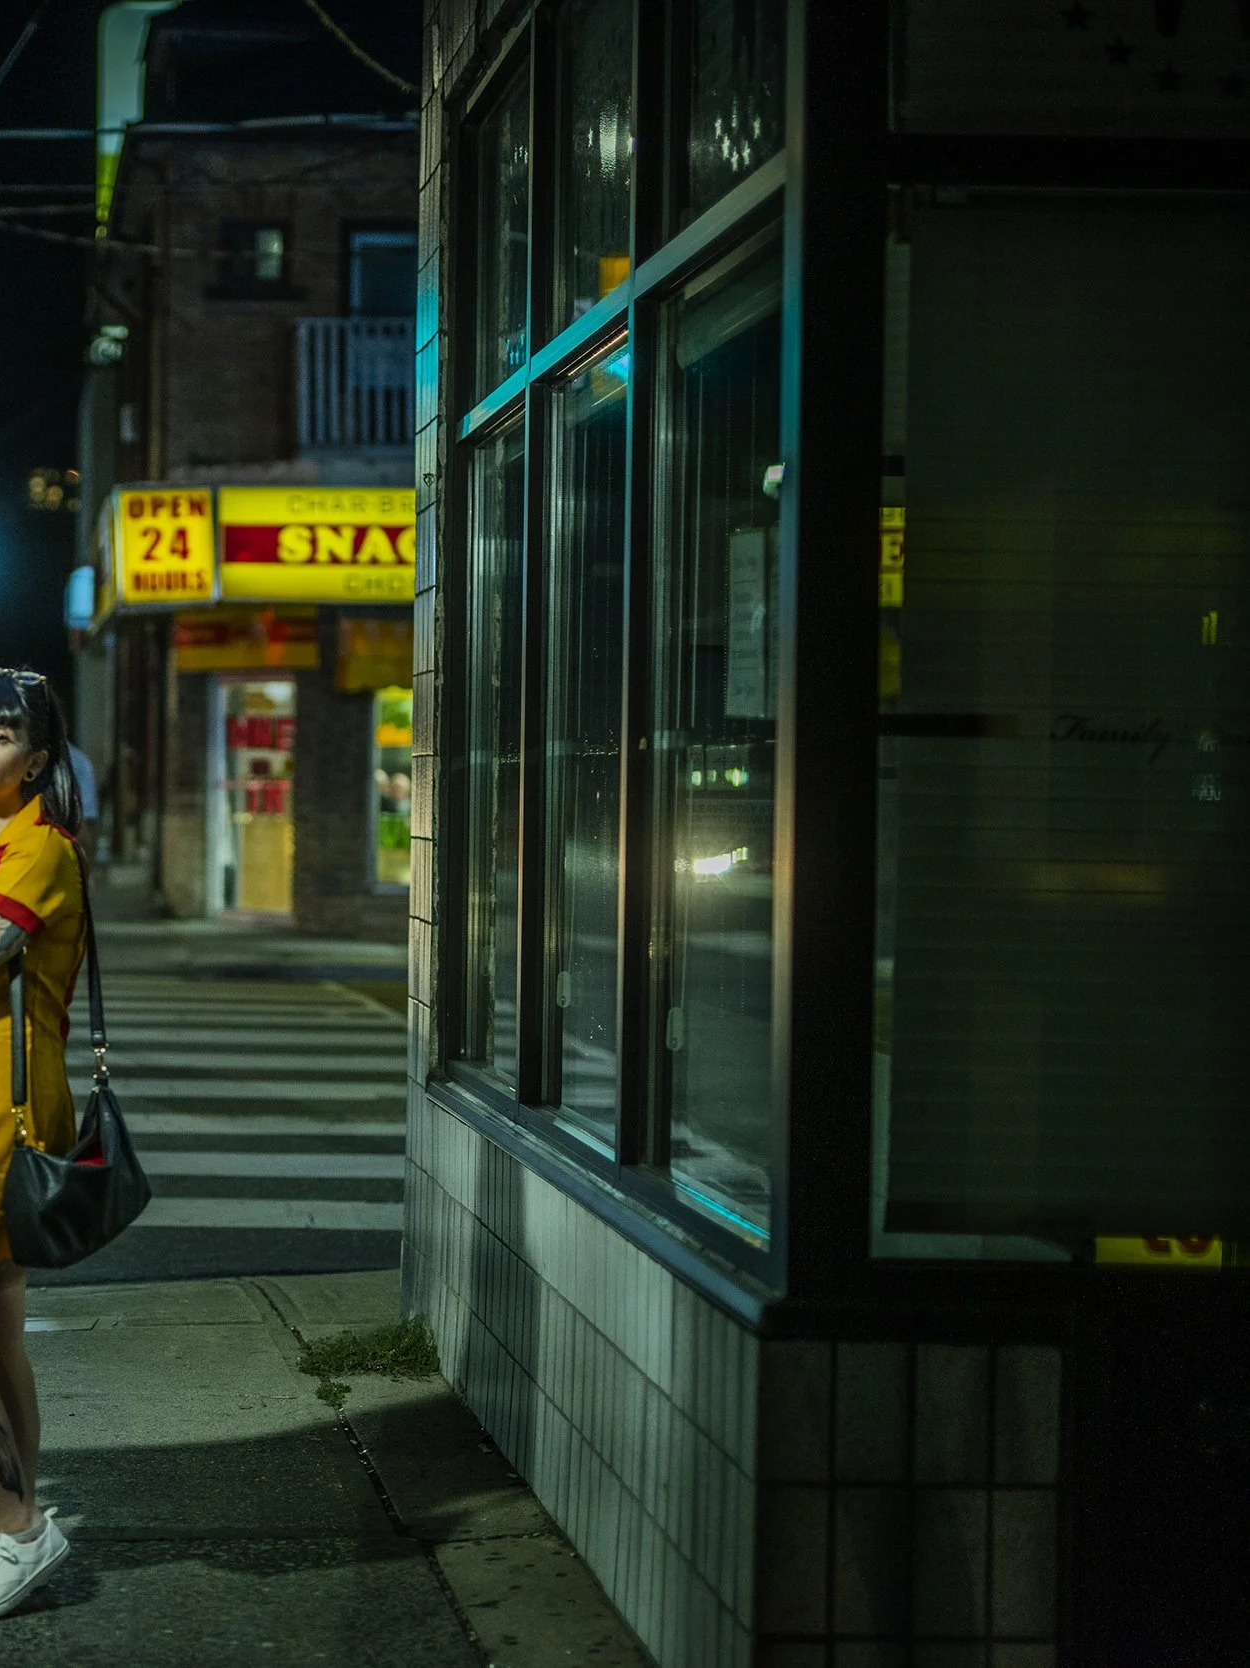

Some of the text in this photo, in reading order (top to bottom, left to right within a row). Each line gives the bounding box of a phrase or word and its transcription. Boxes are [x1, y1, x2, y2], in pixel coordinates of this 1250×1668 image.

[128, 495, 207, 518] OPEN
[141, 527, 189, 560] 24
[132, 568, 207, 592] HOURS
